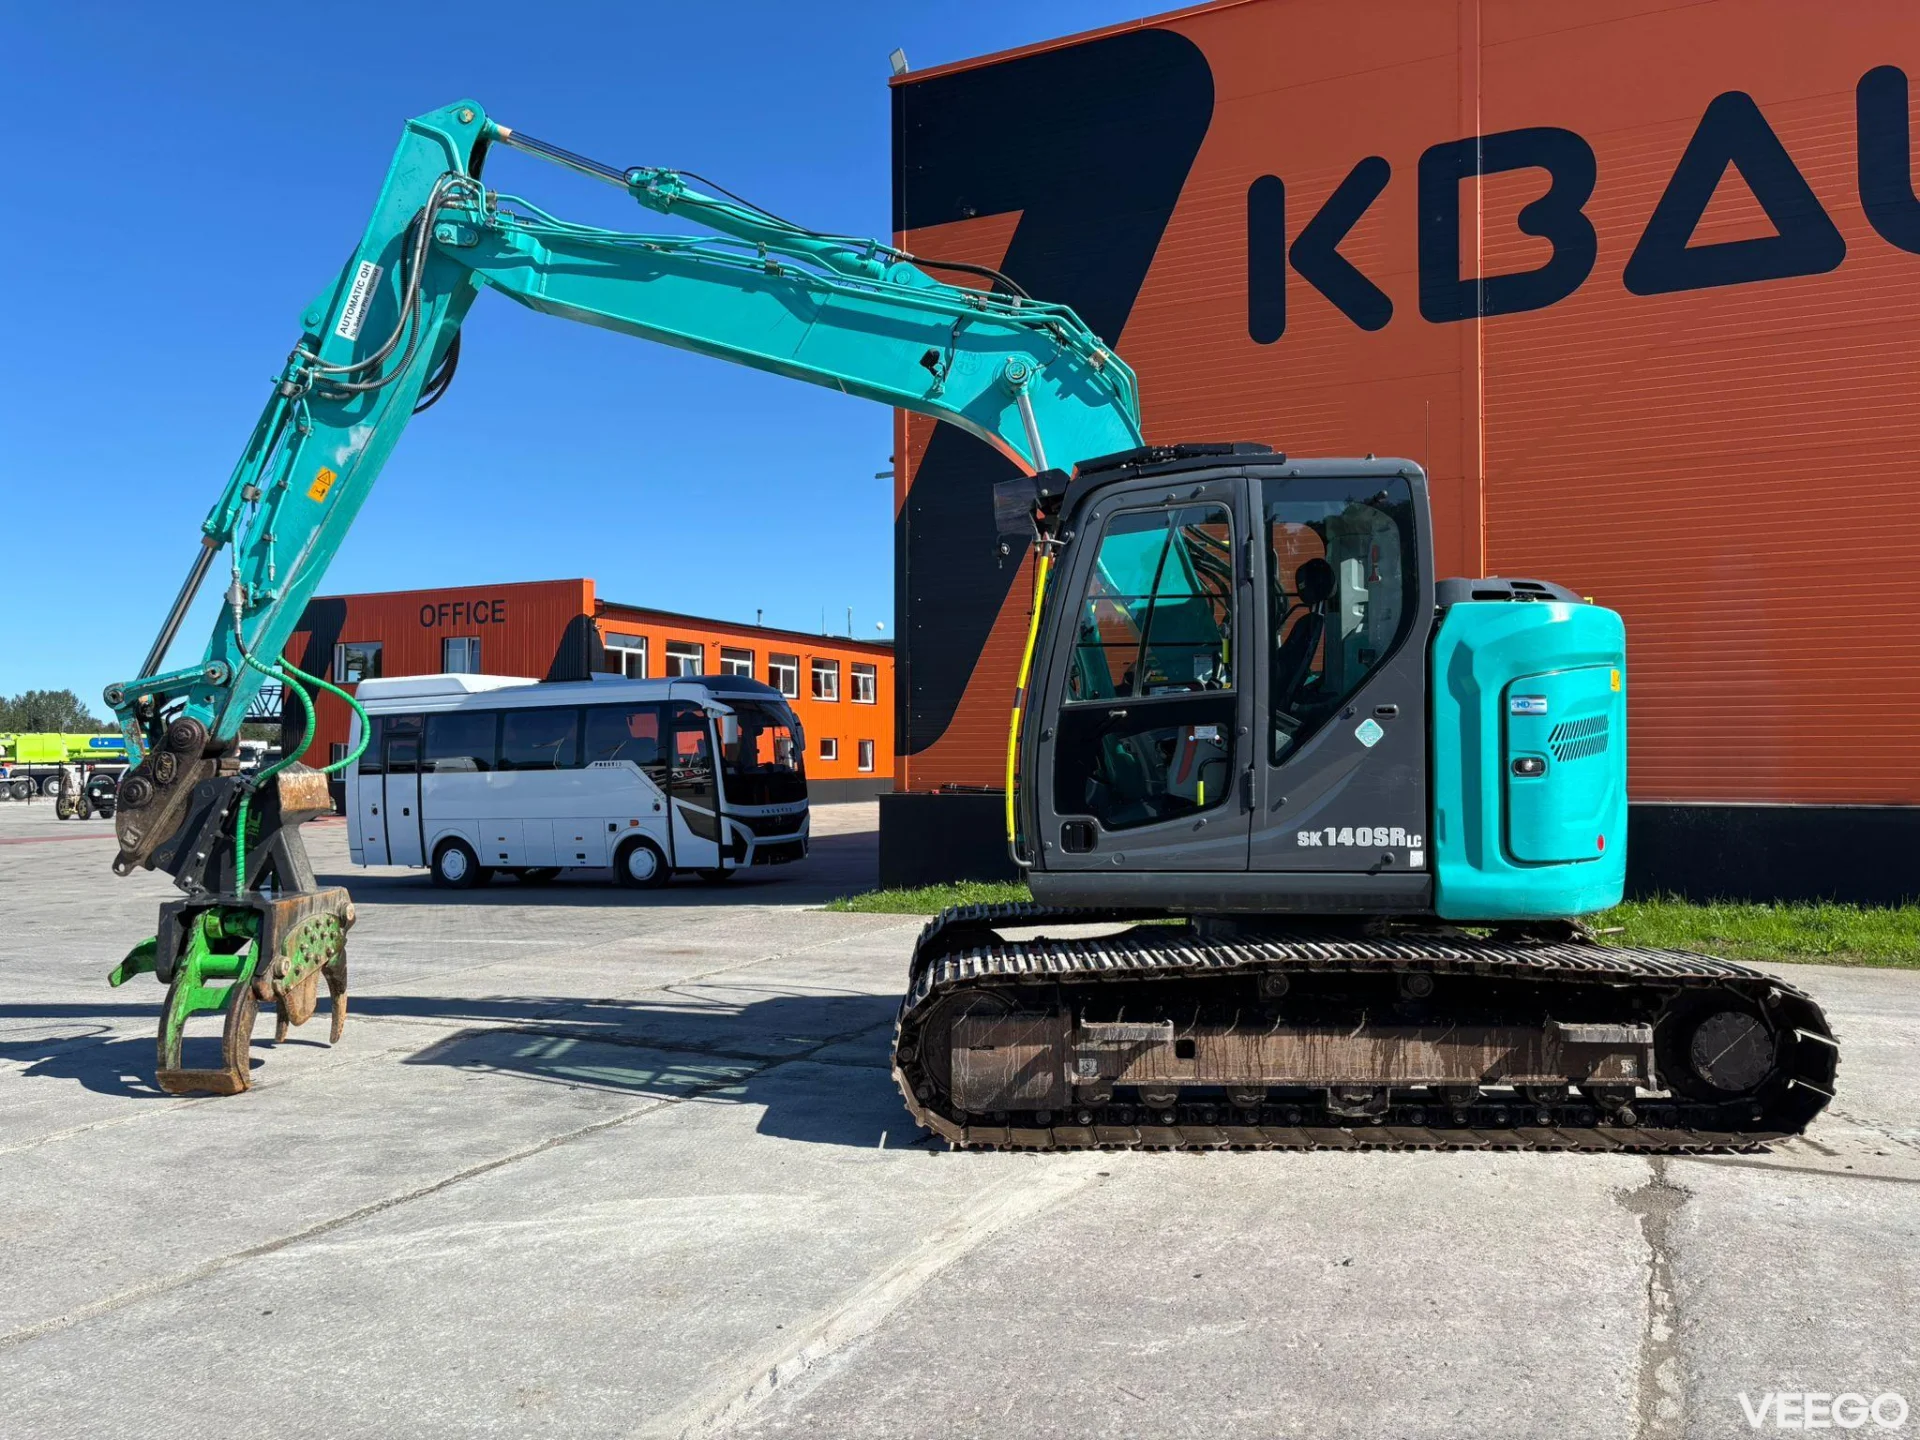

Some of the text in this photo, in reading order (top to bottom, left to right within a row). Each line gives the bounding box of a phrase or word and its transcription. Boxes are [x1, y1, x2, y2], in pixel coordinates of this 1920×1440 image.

[339, 264, 371, 334] AUTOMATIC QH
[353, 308, 365, 328] Safety
[361, 296, 369, 307] Pin
[420, 600, 505, 628] OFFICE
